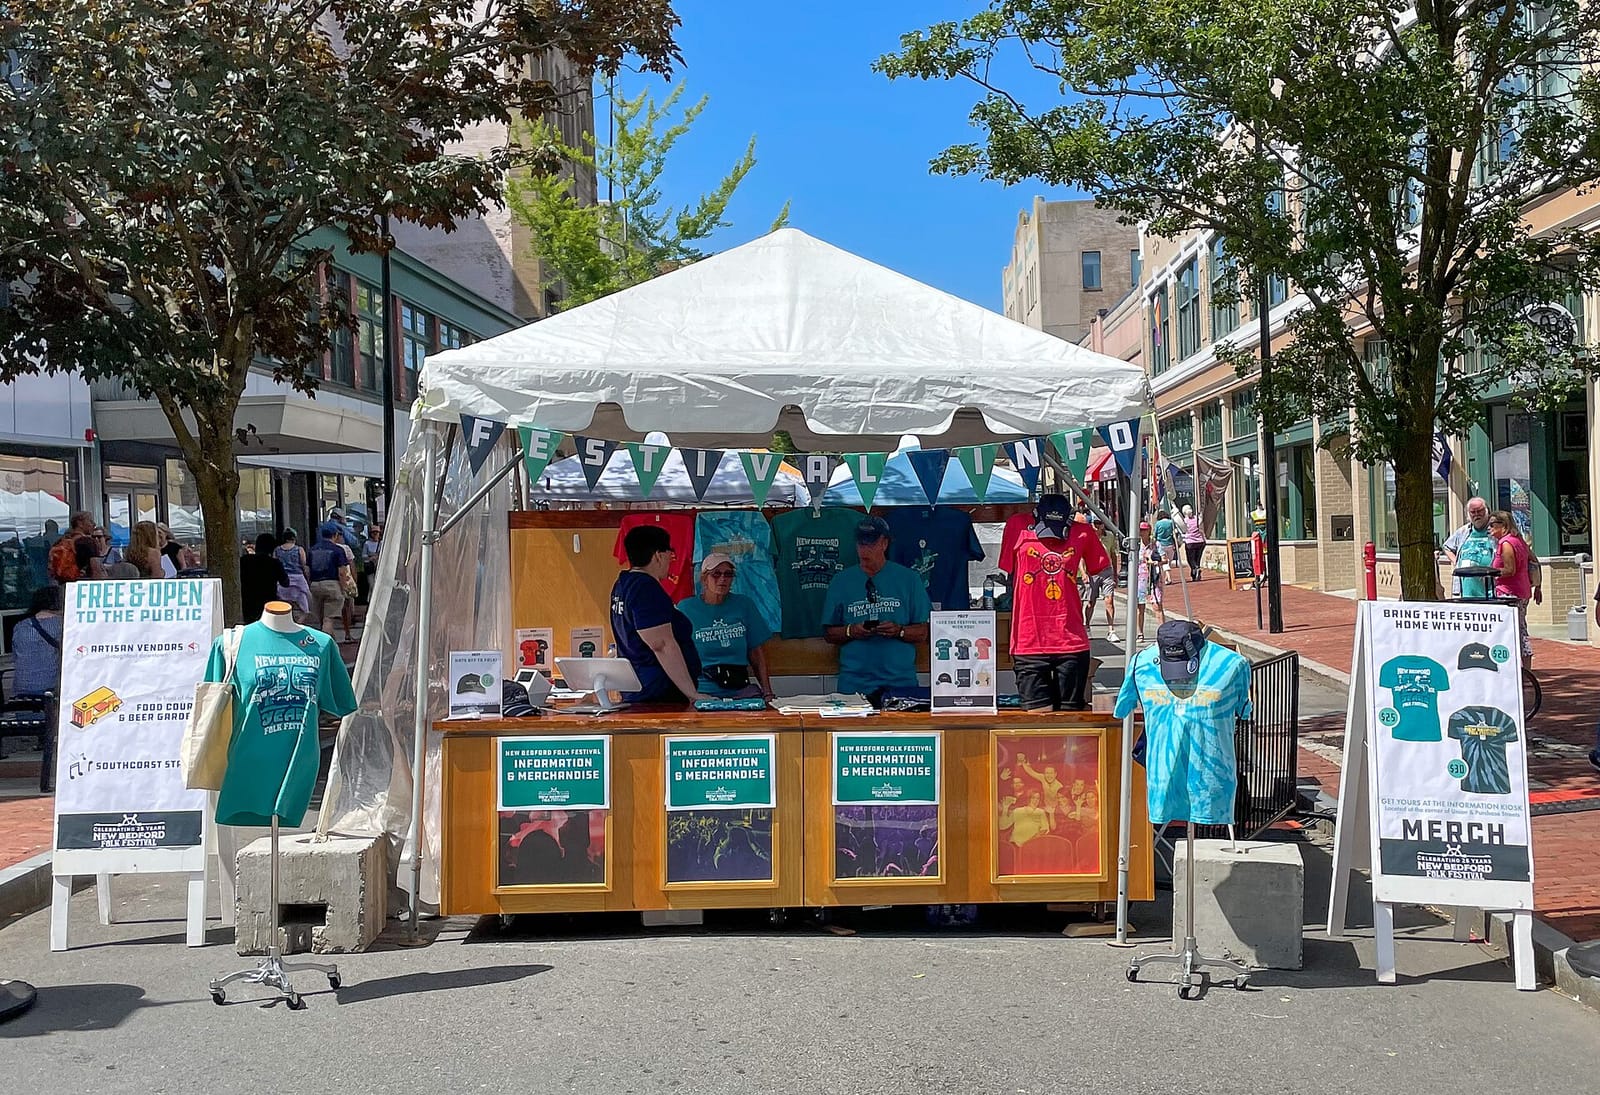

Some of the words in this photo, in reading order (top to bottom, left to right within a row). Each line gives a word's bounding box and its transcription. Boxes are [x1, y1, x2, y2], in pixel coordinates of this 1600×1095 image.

[471, 421, 877, 482] FESTIVAL
[973, 421, 1132, 475] INFO
[76, 582, 126, 608] FREE
[130, 582, 146, 608] &
[148, 580, 203, 608] OPEN
[848, 604, 865, 613] NEW
[865, 601, 901, 609] BEDFORD
[76, 610, 96, 623] TO
[102, 610, 134, 622] THE
[140, 608, 202, 622] PUBLIC
[1384, 610, 1420, 619] BRING
[1425, 611, 1446, 620] THE
[1450, 612, 1504, 622] FESTIVAL
[1396, 620, 1428, 630] HOME
[1432, 622, 1460, 631] WITH
[1464, 623, 1492, 632] YOU!
[696, 630, 713, 640] NEW
[90, 644, 134, 654] ARTISAN
[138, 642, 184, 652] VENDORS
[1492, 648, 1508, 659] $20
[255, 656, 277, 669] NEW
[278, 655, 320, 669] BEDFORD
[136, 703, 162, 712] FOOD
[166, 702, 192, 710] COUR
[118, 714, 126, 722] &
[128, 713, 154, 722] BEER
[158, 712, 190, 720] GARD
[1381, 712, 1396, 722] $25
[264, 723, 283, 736] FOLK
[514, 758, 592, 768] INFORMATION
[682, 757, 758, 768] INFORMATION
[848, 754, 924, 764] INFORMATION
[96, 760, 162, 770] SOUTHCOAST
[165, 760, 181, 768] STA
[1450, 764, 1464, 773] $30
[507, 772, 514, 780] &
[518, 770, 600, 780] MERCHANDISE
[674, 771, 682, 780] &
[685, 770, 766, 780] MERCHANDISE
[842, 768, 850, 776] &
[852, 766, 931, 776] MERCHANDISE
[1447, 801, 1499, 810] INFORMATION
[93, 832, 116, 841] NEW
[118, 830, 166, 840] BEDFORD
[1402, 818, 1504, 845] MERCH
[100, 840, 121, 848] FOLK
[122, 838, 158, 847] FESTIVAL
[1417, 855, 1461, 863] CELEBRATING
[1418, 862, 1442, 871] NEW
[1444, 863, 1492, 874] BEDFORD
[1426, 870, 1446, 878] FOLK
[1448, 870, 1484, 880] FESTIVAL
